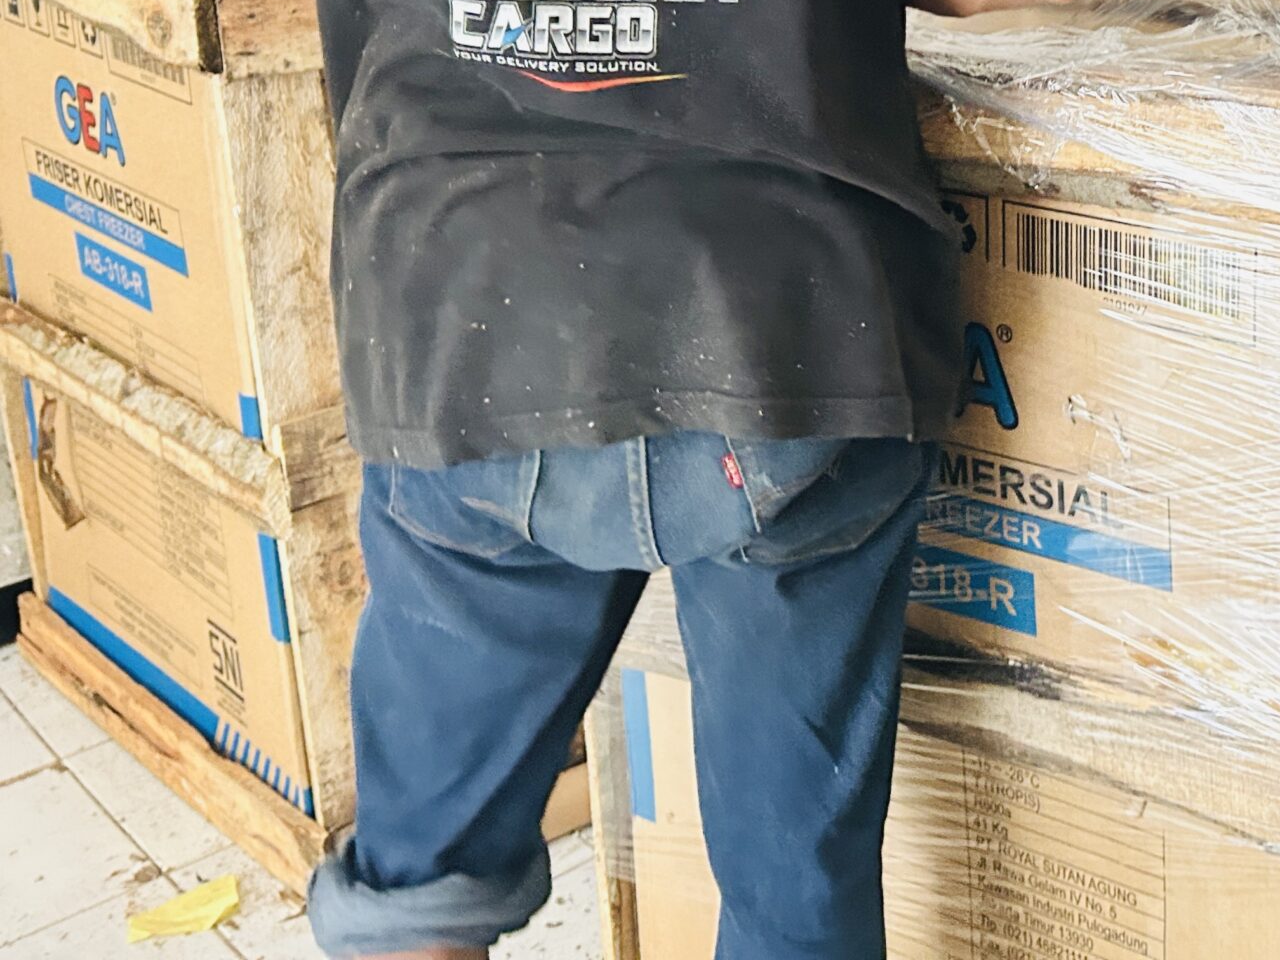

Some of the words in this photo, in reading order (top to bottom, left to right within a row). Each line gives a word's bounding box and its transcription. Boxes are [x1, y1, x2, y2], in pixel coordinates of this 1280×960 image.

[447, 0, 659, 58] CARGO
[454, 49, 492, 64] YOUR
[496, 55, 570, 73] DELIVERY
[55, 75, 125, 168] GEA
[35, 150, 82, 193] FRISER
[83, 171, 168, 235] KOMERSIAL
[97, 209, 147, 251] FREEZER
[938, 448, 1126, 532] MERSIAL
[926, 499, 1043, 550] REEZER
[203, 629, 245, 693] SNI
[999, 841, 1040, 869] ROYAL
[1043, 858, 1086, 888] SUTAN
[1089, 878, 1138, 908] AGUNG
[1070, 890, 1082, 906] IV
[976, 874, 1030, 905] Kawasan
[1032, 894, 1075, 924] Industri
[1078, 913, 1149, 956] Pulogadung
[1003, 923, 1033, 948] (021)
[1023, 911, 1056, 936] Timur
[1059, 925, 1095, 953] 13930
